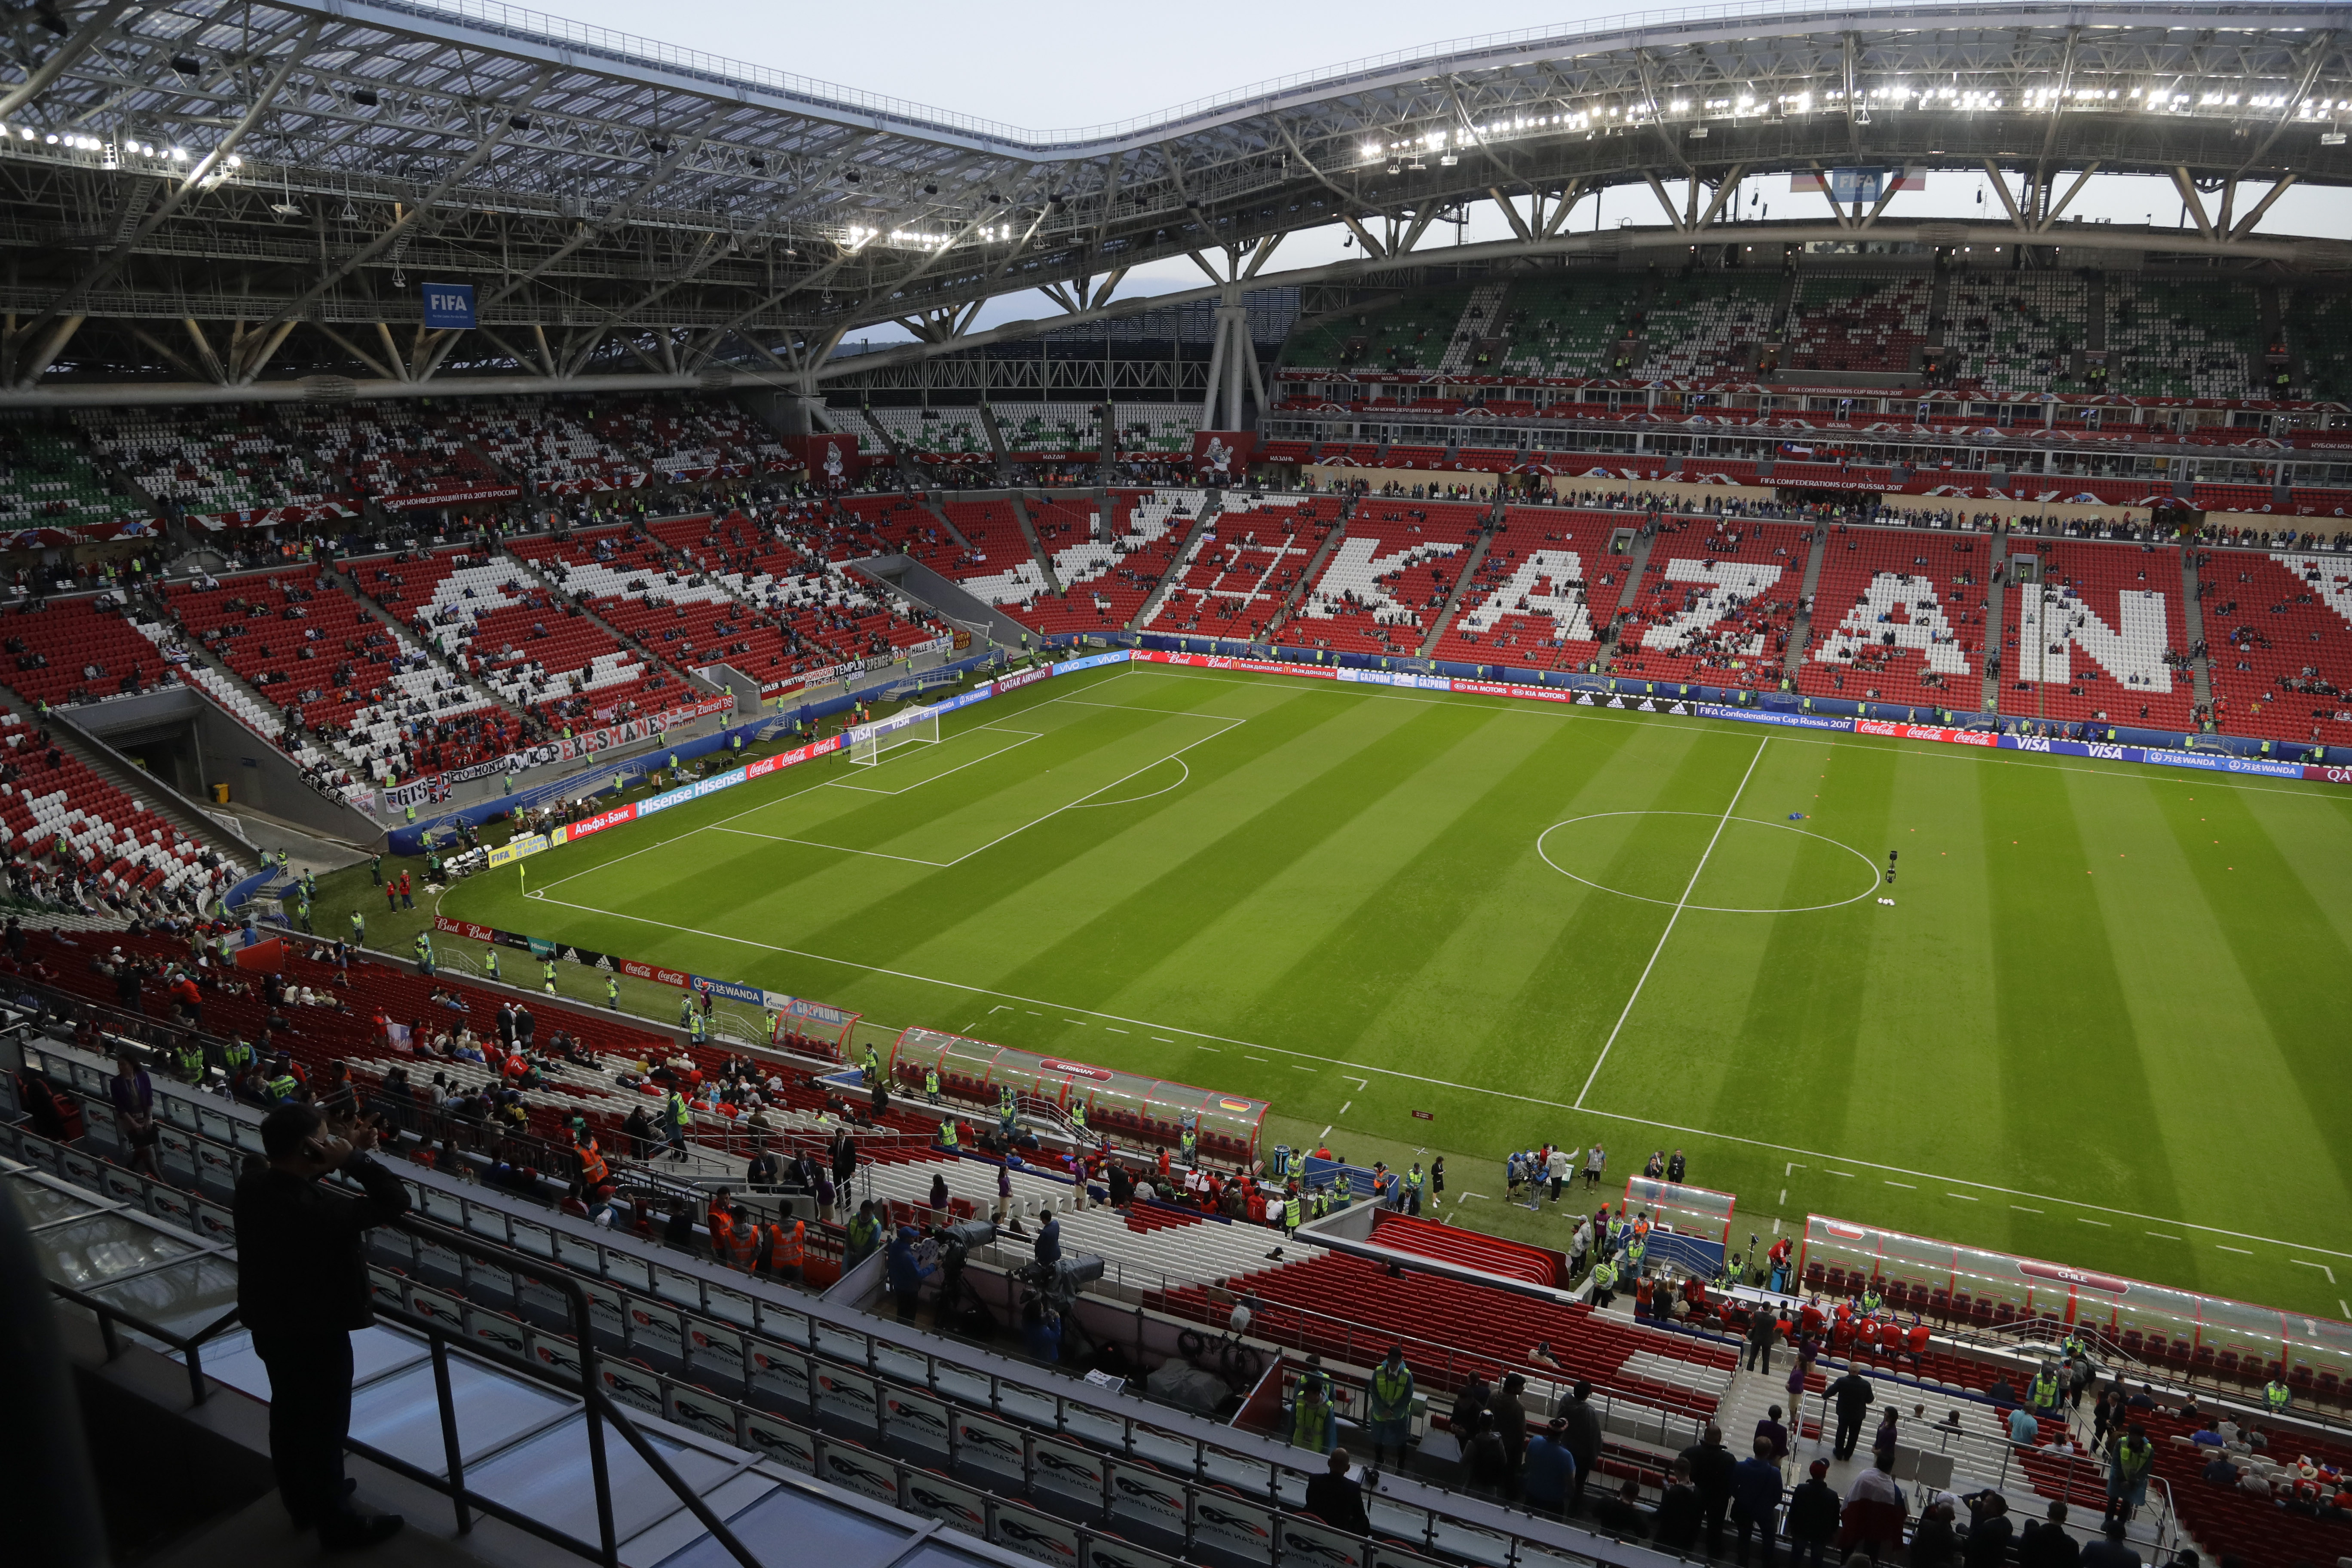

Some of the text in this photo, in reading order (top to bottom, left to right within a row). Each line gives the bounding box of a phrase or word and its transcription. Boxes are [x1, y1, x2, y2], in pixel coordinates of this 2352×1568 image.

[1840, 175, 1875, 188] FIFA
[430, 294, 468, 311] FIFA
[1776, 478, 1840, 489] CONFEDERATIONS
[1857, 482, 1885, 490] RUSSIA
[407, 493, 459, 505] КОНФЕДЕРАЦИЙ
[493, 489, 518, 497] РОССИИ
[1305, 536, 2173, 693] KAZAN
[912, 642, 928, 655] HALLE
[867, 654, 889, 671] SPENGE
[1130, 650, 1153, 662] Bud
[1167, 653, 1191, 665] Bud
[1206, 656, 1230, 668] Bud
[805, 667, 834, 681] ROHRDORF
[834, 659, 865, 676] TEMPLIN
[1240, 662, 1283, 672] Макдоналдс
[1292, 668, 1335, 678] Макдоналдс
[761, 675, 805, 694] ADLER BRETTEN
[805, 676, 839, 690] BRACHELEN
[1000, 668, 1046, 693] QATAR AIRWAYS
[1360, 672, 1390, 684] GAZPROM
[1418, 679, 1450, 689] GAZPROM
[1537, 691, 1566, 700] MOTORS
[890, 713, 910, 730] VISA
[1700, 707, 1851, 729] FIFA Confederations Cup Russia 2017
[849, 726, 872, 744] VISA
[2013, 736, 2050, 753] VISA
[2085, 744, 2122, 760] VISA
[451, 758, 506, 781] PTO MONTT
[397, 783, 429, 806] GTS
[638, 768, 746, 816] Hisense Hisense
[515, 836, 546, 851] MY GAME
[523, 845, 538, 855] FAIR
[491, 850, 510, 863] FIFA
[434, 916, 459, 933] Bud
[466, 924, 493, 941] Bud
[563, 956, 581, 964] adidas
[595, 963, 614, 972] adidas
[796, 1001, 840, 1022] GAZPROM
[514, 1062, 522, 1070] 7
[1057, 1064, 1096, 1076] GERMANY
[2058, 1271, 2088, 1283] CHILE
[1866, 1324, 1874, 1333] 9
